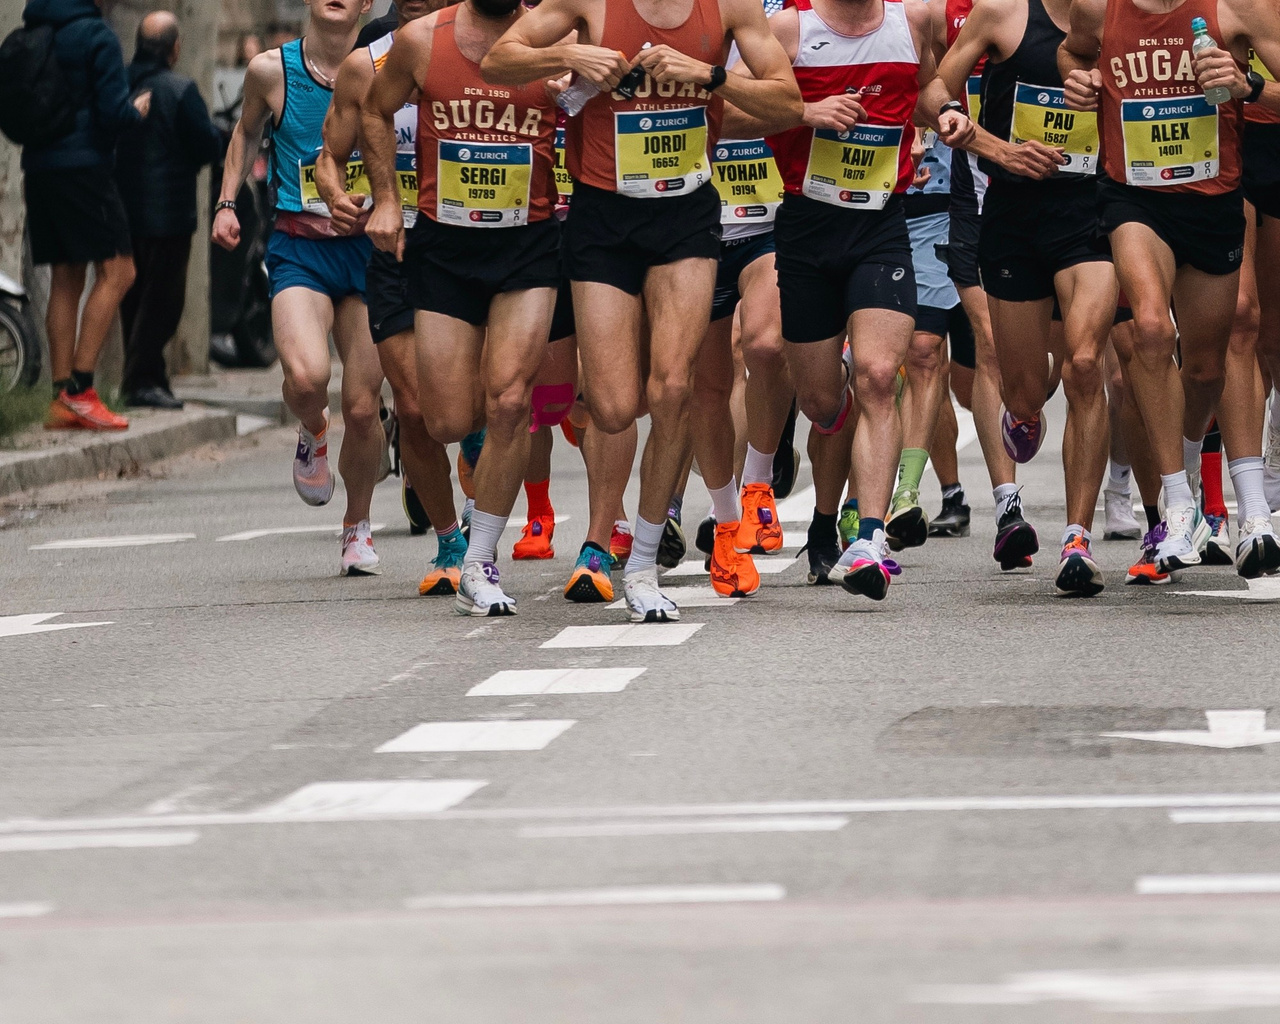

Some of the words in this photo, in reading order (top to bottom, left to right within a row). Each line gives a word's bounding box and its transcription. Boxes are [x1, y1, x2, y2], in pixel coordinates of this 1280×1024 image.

[1139, 38, 1160, 46] BCN.
[1163, 38, 1184, 46] 1950
[1110, 49, 1196, 88] SUGA
[464, 87, 485, 96] BCN.
[488, 89, 510, 99] 1950
[1134, 86, 1196, 96] ATHLETICS
[1158, 106, 1193, 116] ZURICH
[432, 99, 542, 136] SUGAR
[656, 117, 688, 126] ZURICH
[1043, 110, 1075, 131] PAU
[455, 132, 517, 142] ATHLETICS
[852, 132, 884, 142] ZURICH
[1044, 132, 1068, 144] 15821
[1151, 122, 1190, 143] ALEX
[644, 133, 686, 155] JORDI
[474, 151, 508, 160] ZURICH
[732, 146, 764, 156] ZURICH
[841, 146, 875, 167] XAVI
[1158, 144, 1183, 157] 14011
[652, 156, 680, 169] 16652
[460, 166, 506, 186] SERGI
[716, 162, 768, 182] YOHAN
[842, 168, 866, 180] 18176
[468, 188, 496, 200] 19789
[732, 184, 756, 196] 19194
